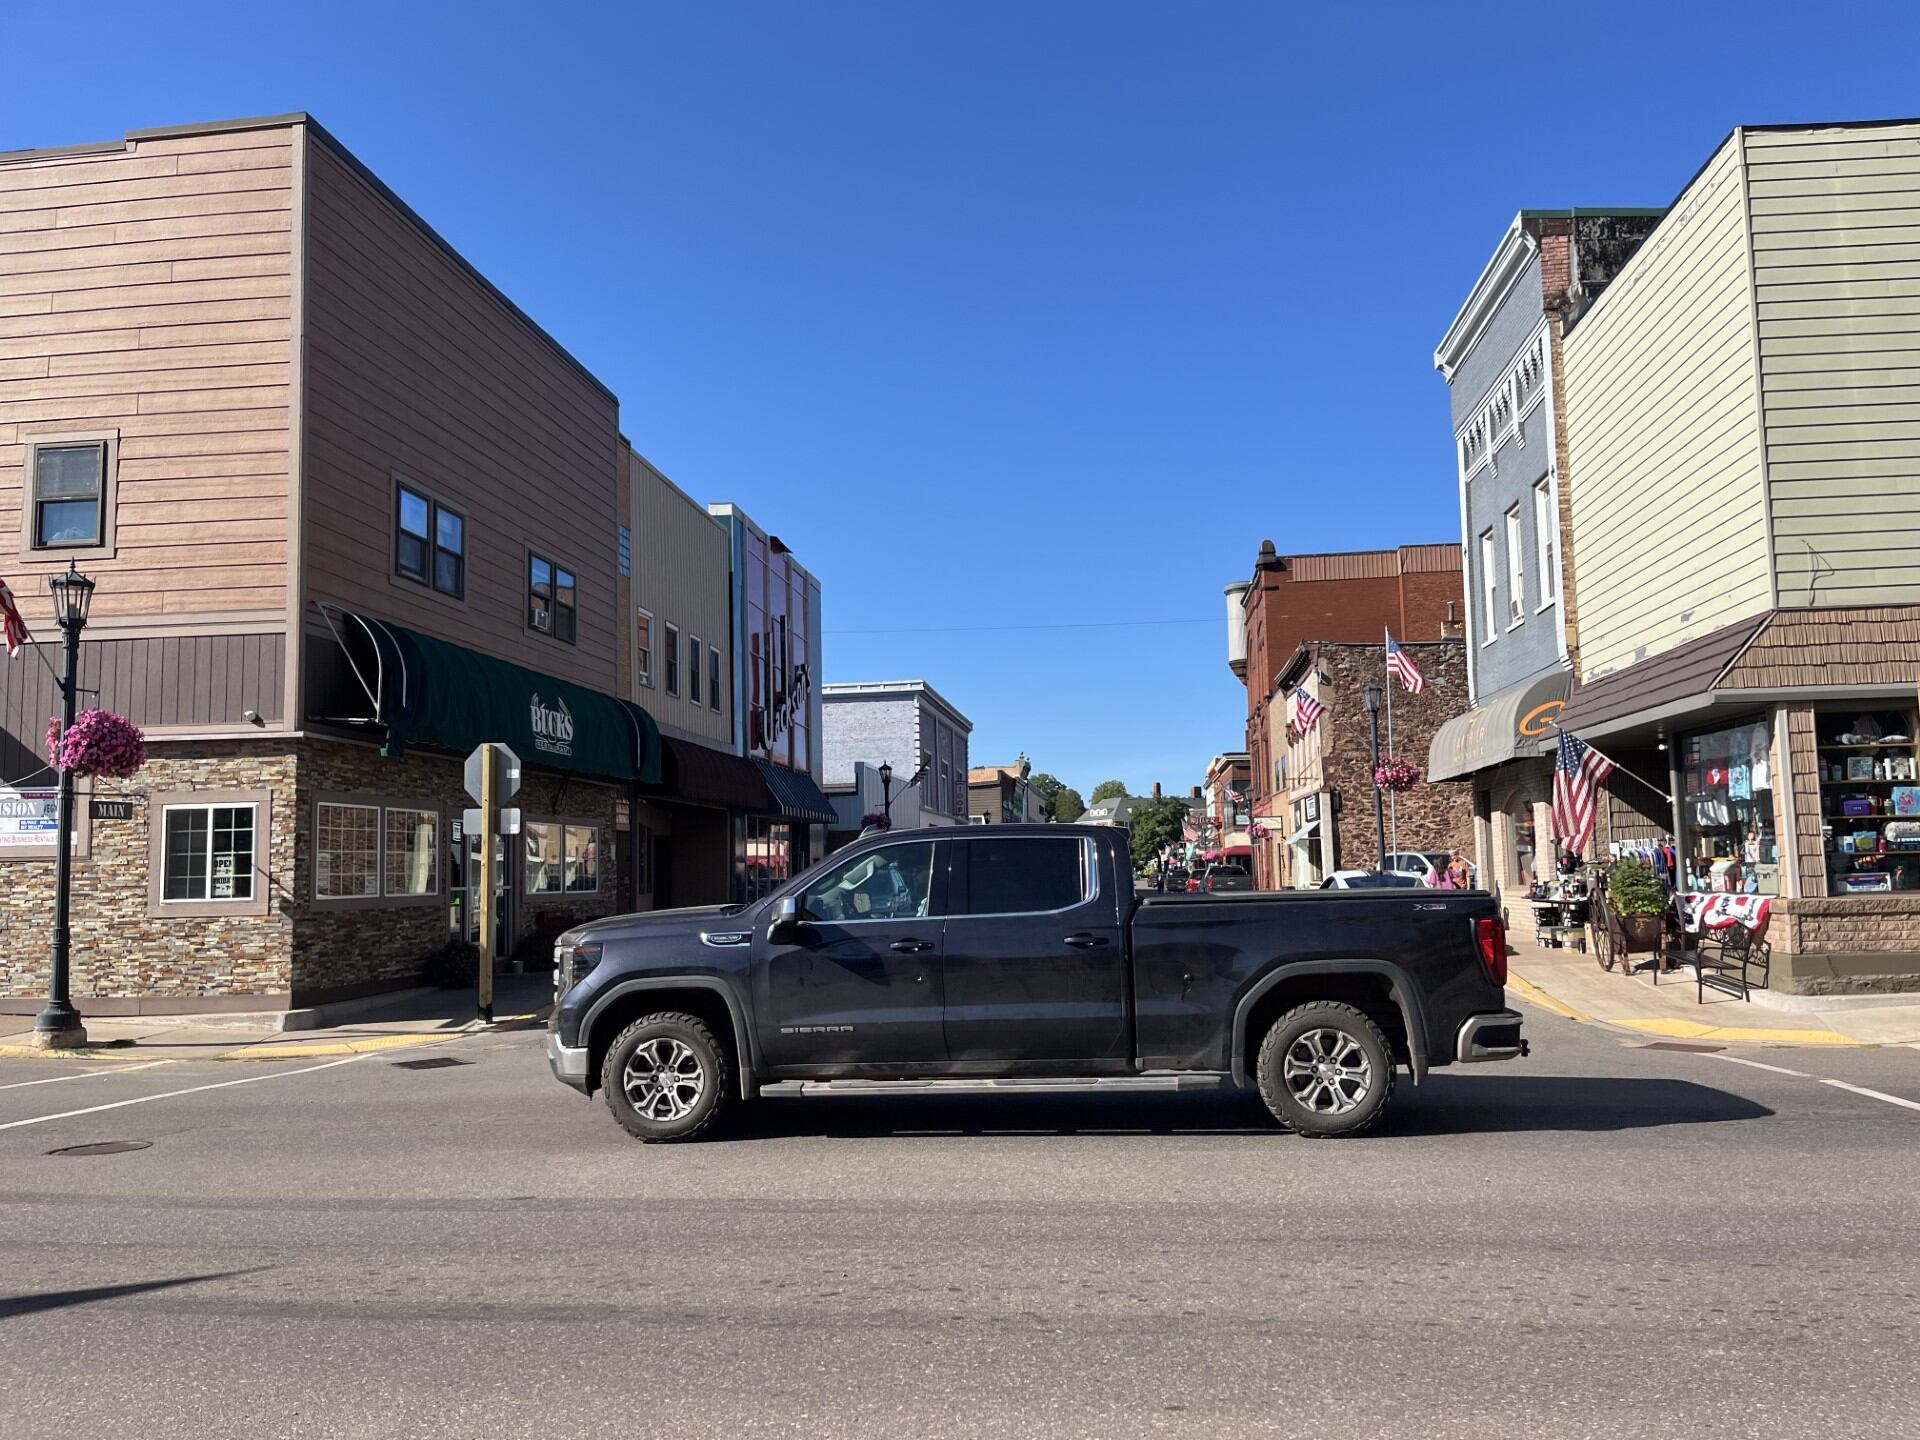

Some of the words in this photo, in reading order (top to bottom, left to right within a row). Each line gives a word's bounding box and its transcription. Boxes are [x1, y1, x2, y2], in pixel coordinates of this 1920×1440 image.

[759, 615, 812, 751] Jackson's
[98, 804, 126, 818] MAIN
[780, 1026, 854, 1034] SIERRA
